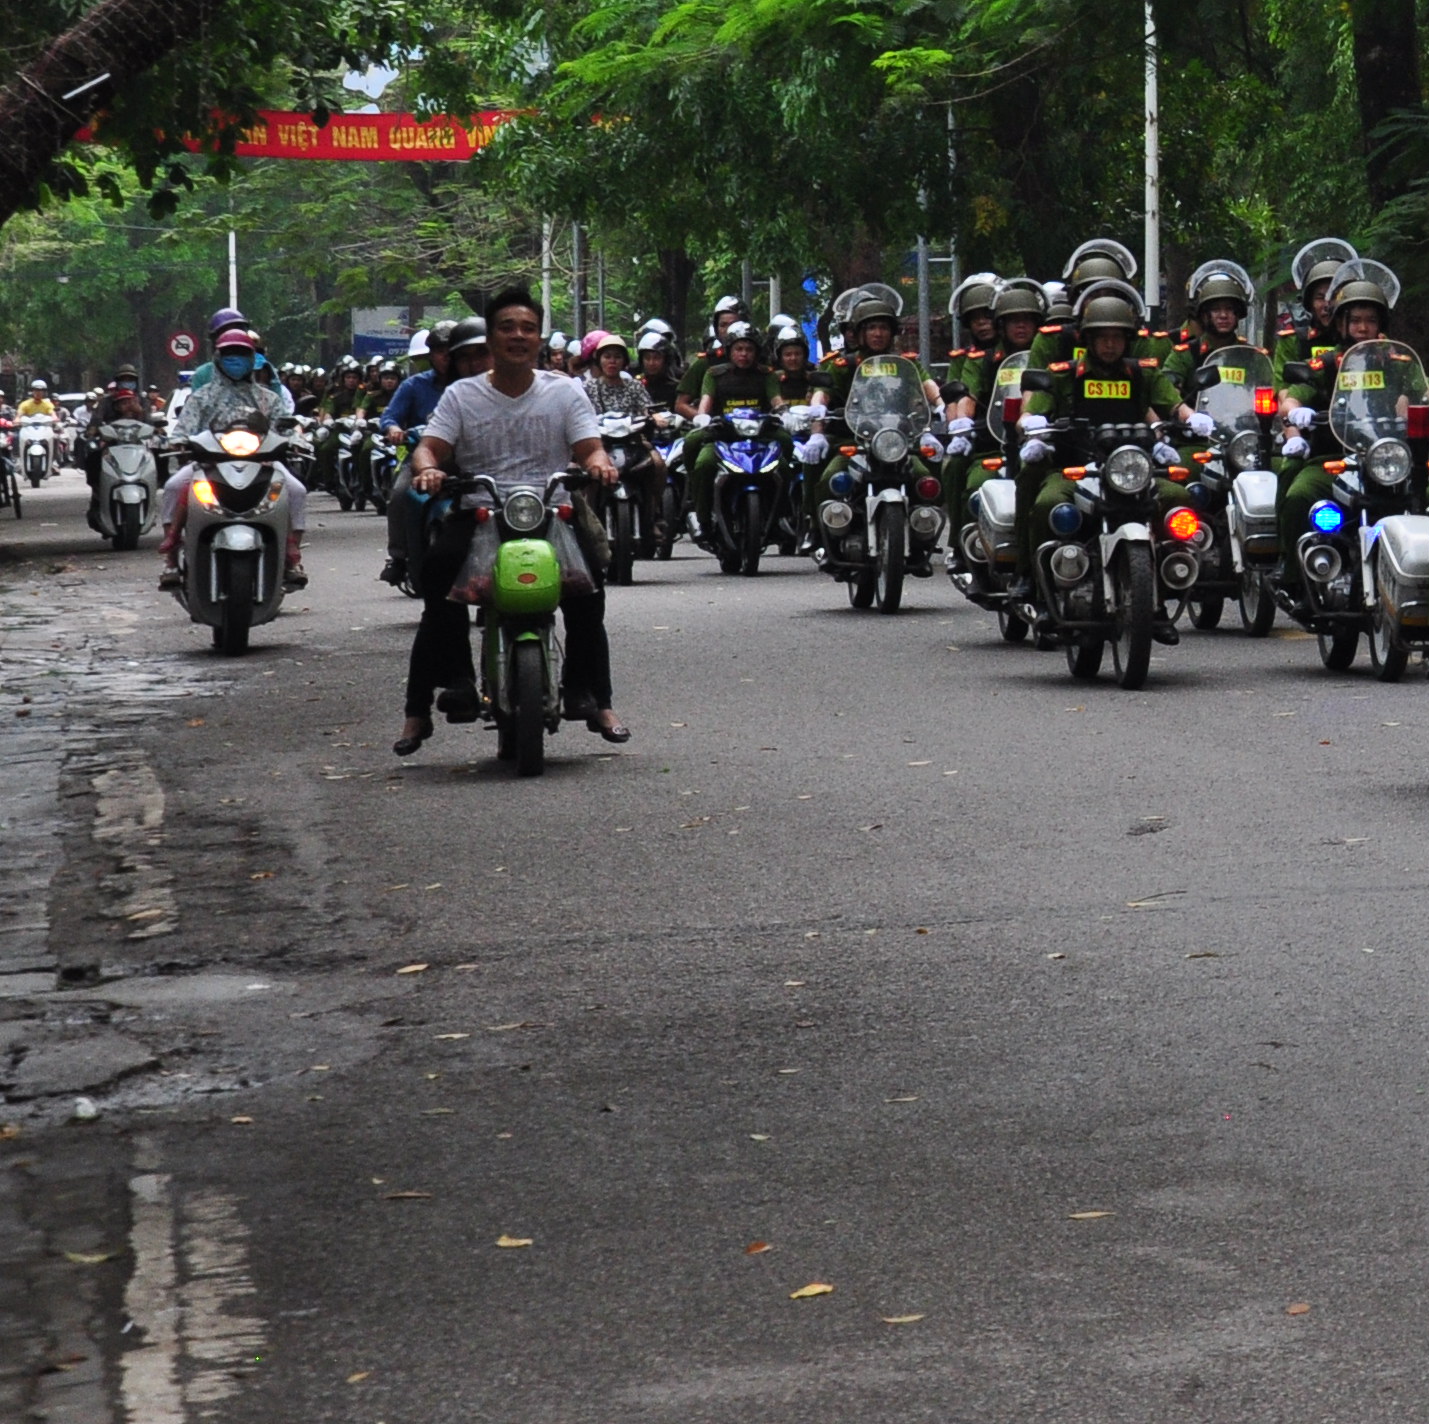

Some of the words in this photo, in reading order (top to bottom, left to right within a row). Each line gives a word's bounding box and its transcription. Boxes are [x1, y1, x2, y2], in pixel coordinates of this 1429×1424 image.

[278, 122, 319, 150] VIỆT
[332, 127, 379, 149] NAM
[388, 126, 456, 150] QUANG
[466, 125, 498, 148] VIN
[1087, 382, 1104, 396] CS
[1107, 383, 1128, 396] 113
